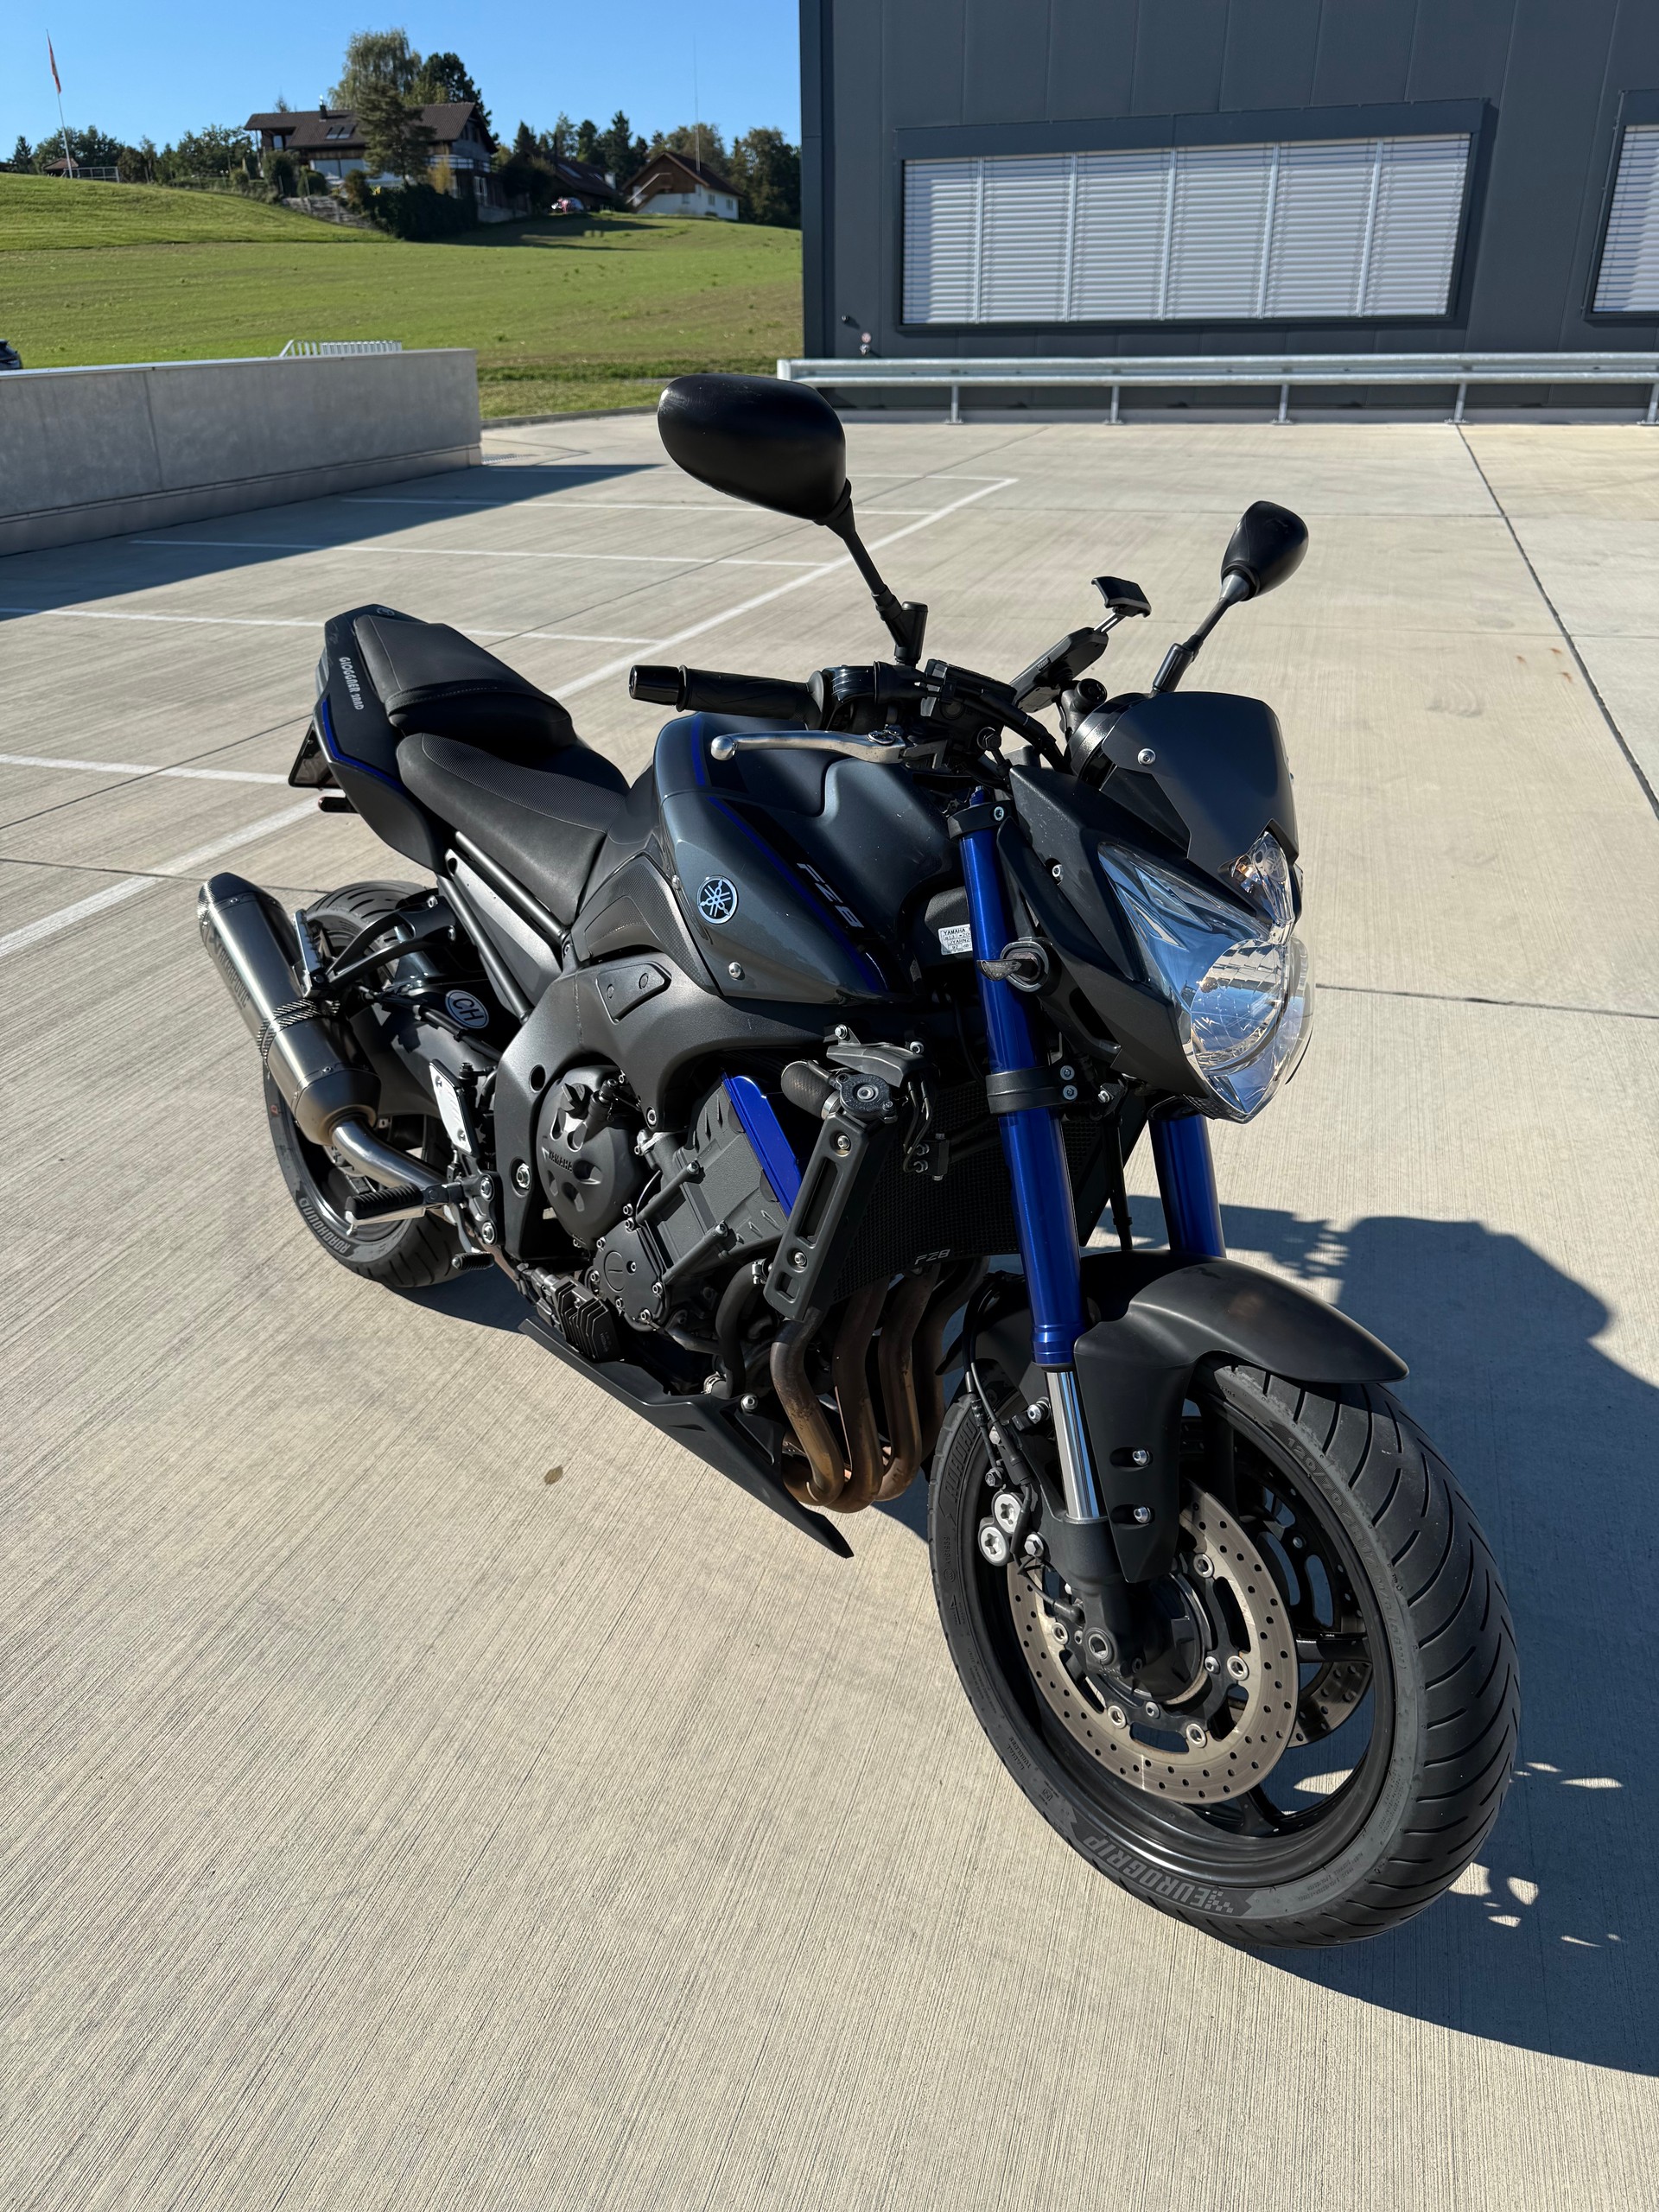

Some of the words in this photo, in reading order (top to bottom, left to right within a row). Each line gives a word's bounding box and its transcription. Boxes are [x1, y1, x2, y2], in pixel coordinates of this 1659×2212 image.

[796, 862, 865, 929] FZ8
[453, 998, 485, 1021] CH
[548, 1149, 573, 1173] YAMAHA
[299, 1198, 351, 1254] ROADHOUND
[914, 1249, 950, 1265] FZ8
[944, 1416, 978, 1503] ROADHO
[1083, 1835, 1211, 1907] EUROGRIP
